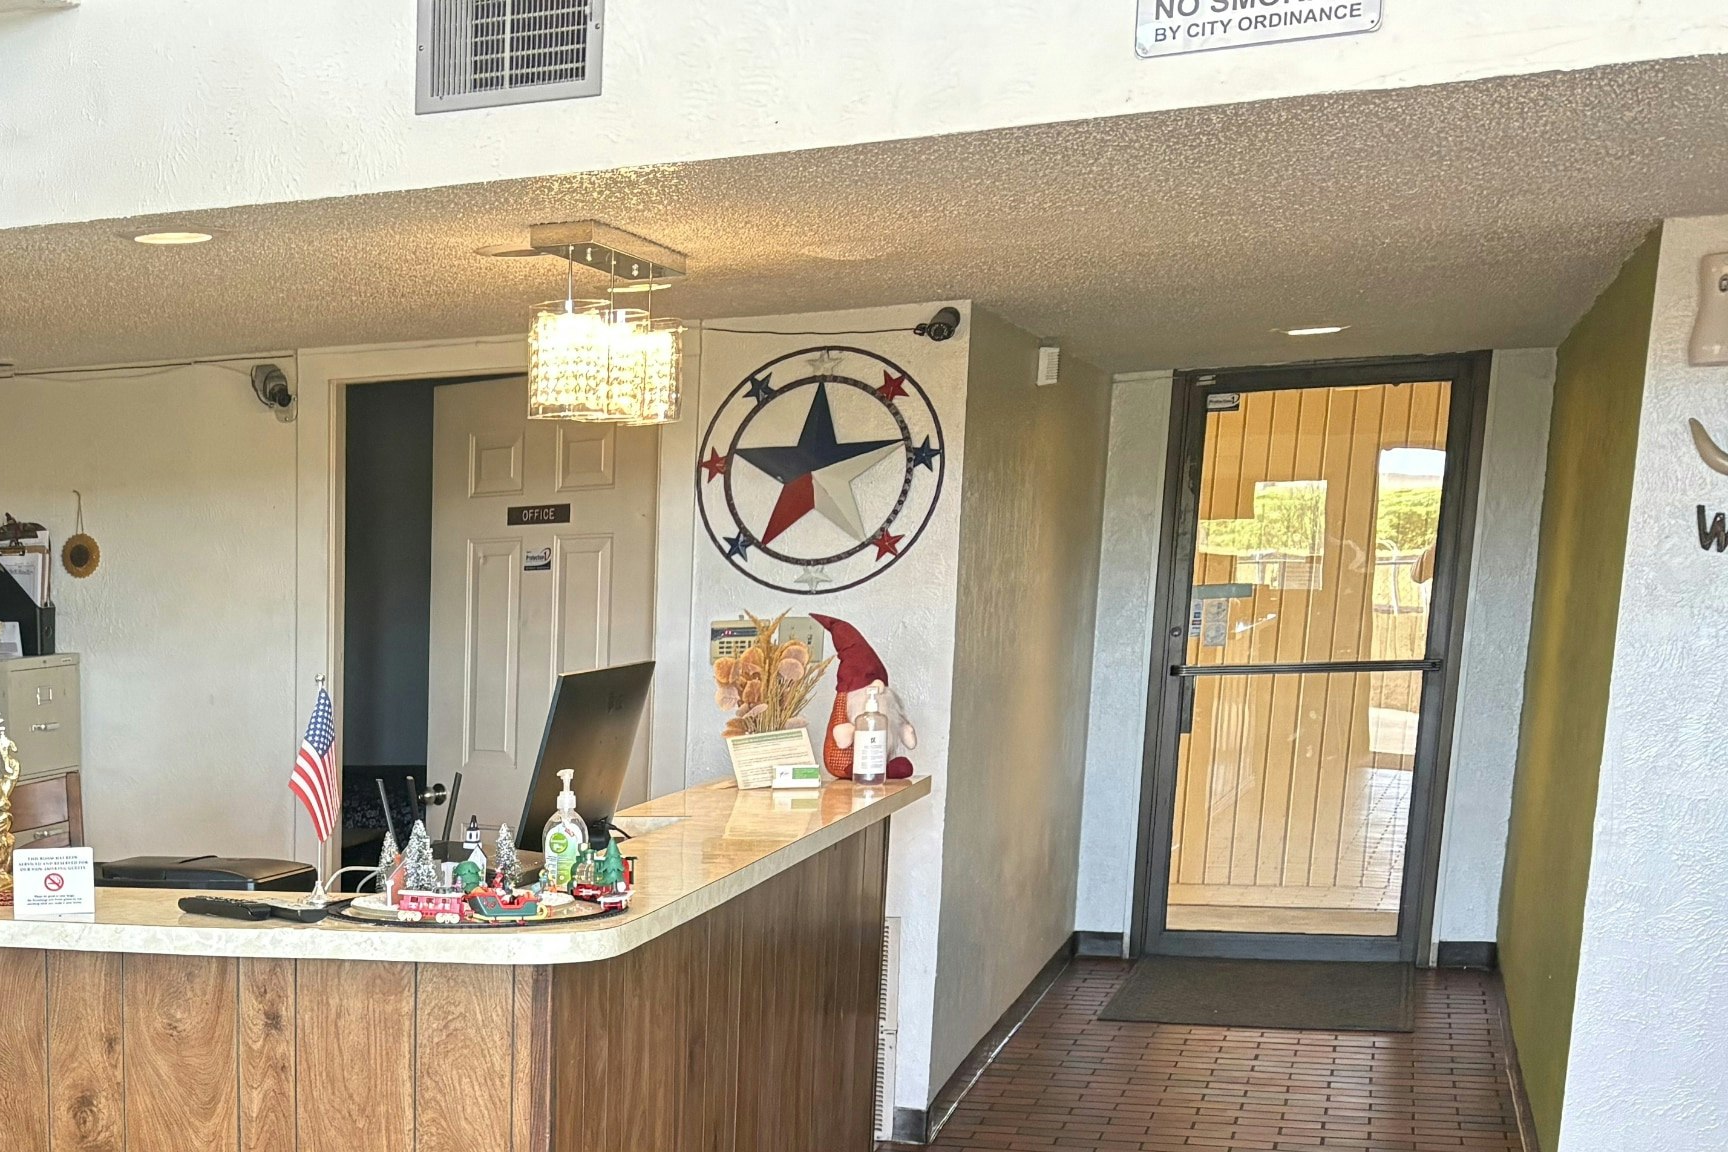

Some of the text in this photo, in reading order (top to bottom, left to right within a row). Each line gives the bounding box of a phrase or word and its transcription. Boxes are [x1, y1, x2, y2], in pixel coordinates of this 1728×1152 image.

[1155, 0, 1199, 21] NO
[1154, 2, 1362, 42] BY CITY ORDINANCE
[522, 508, 555, 521] OFFICE
